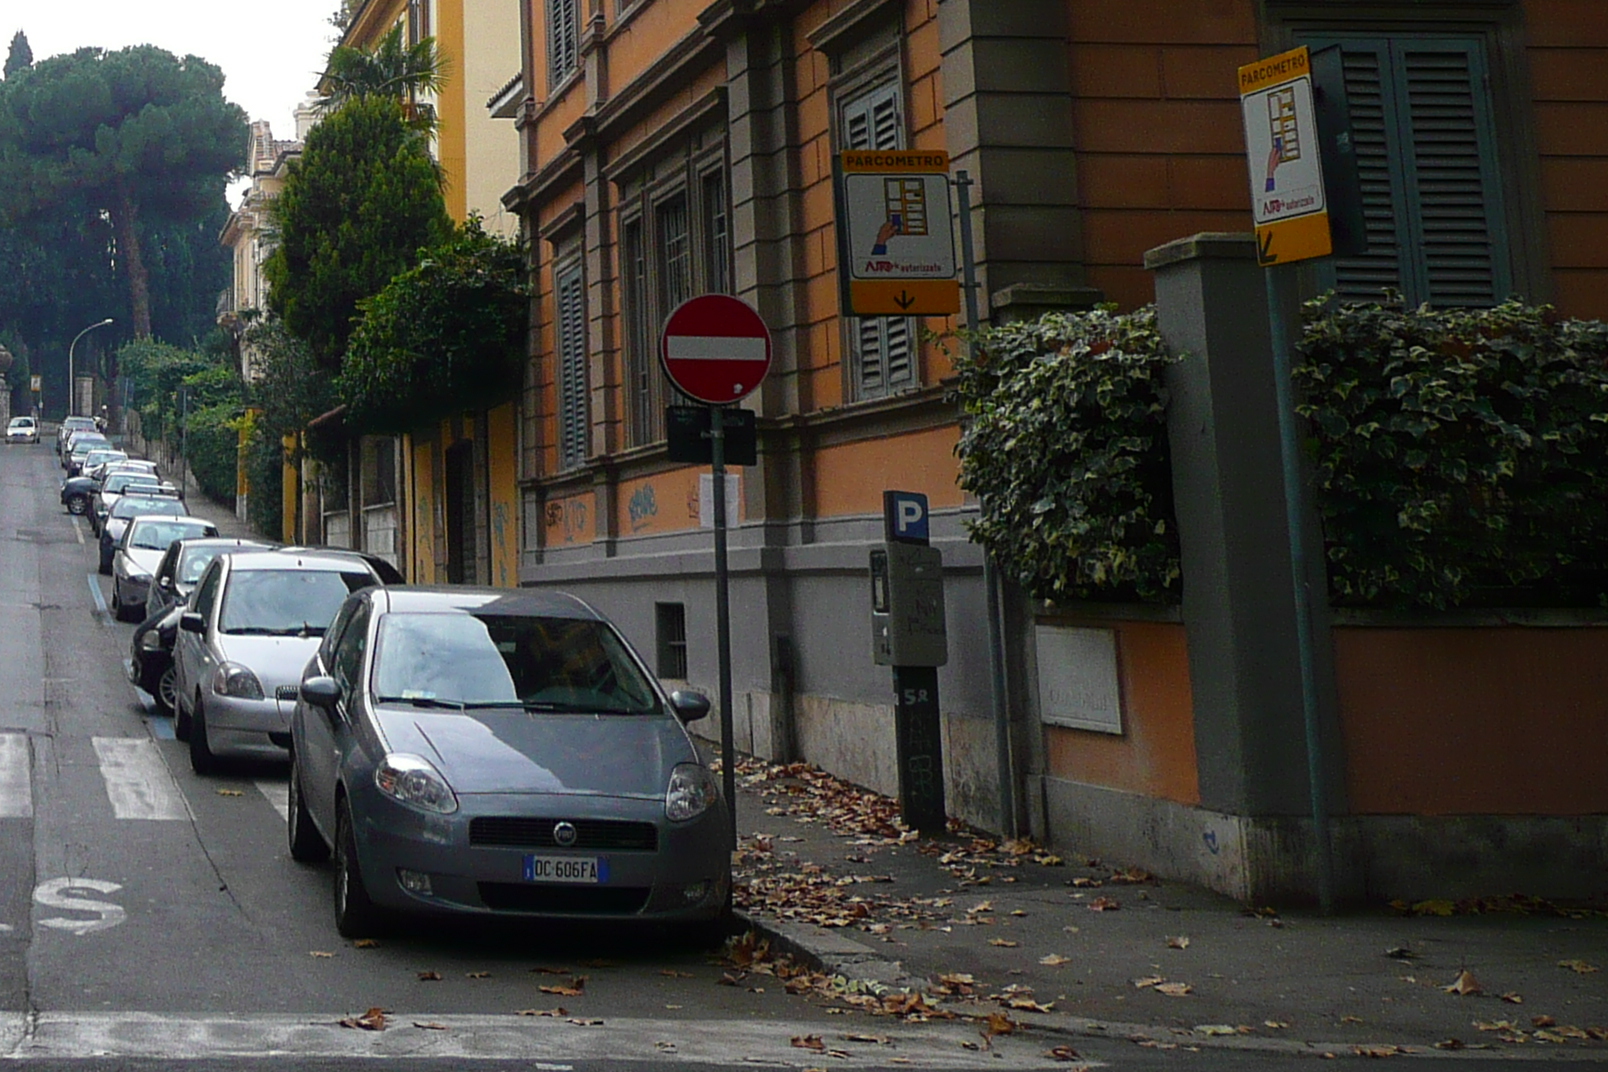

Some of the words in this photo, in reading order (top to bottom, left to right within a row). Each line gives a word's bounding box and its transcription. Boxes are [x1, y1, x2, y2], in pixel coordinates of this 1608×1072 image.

[1241, 54, 1306, 86] PARCOMETRO
[846, 155, 944, 167] PARCOMETRO
[897, 500, 923, 532] P
